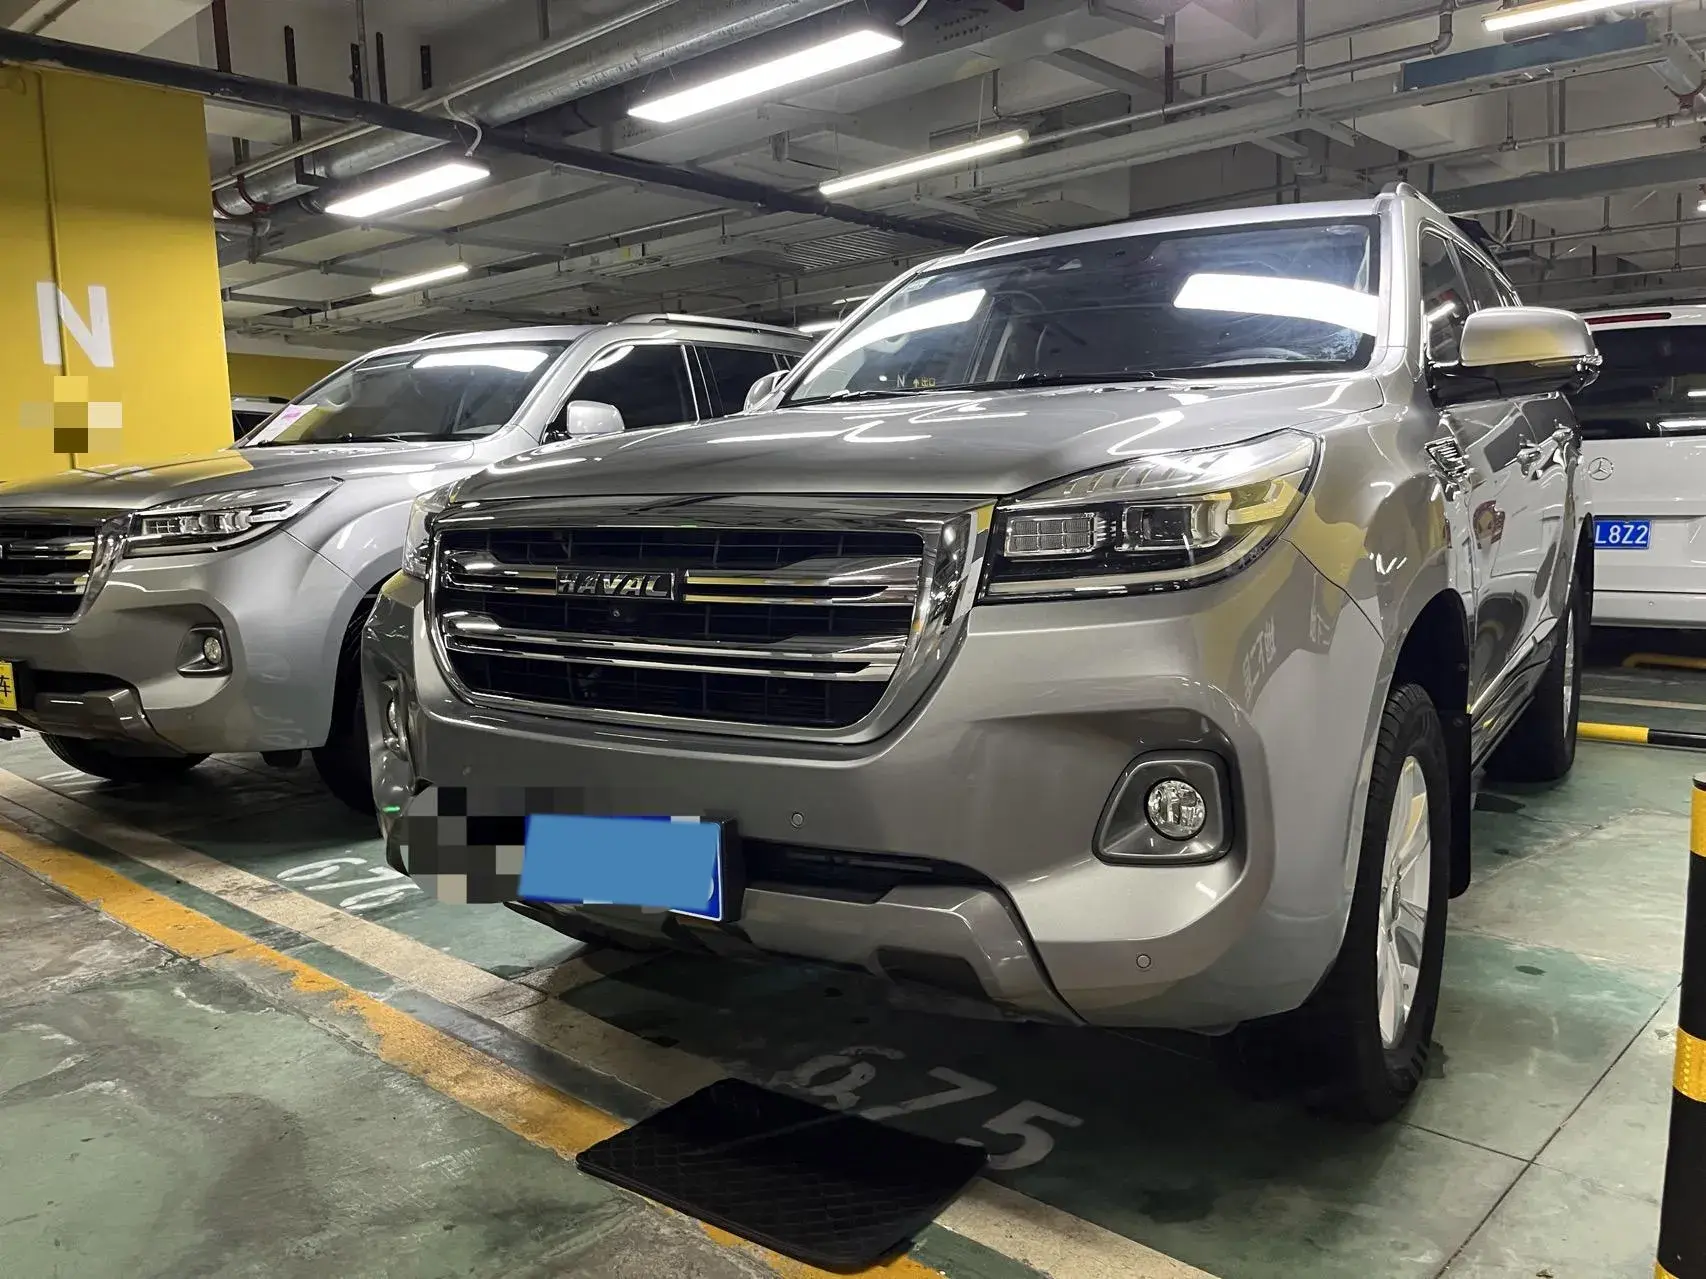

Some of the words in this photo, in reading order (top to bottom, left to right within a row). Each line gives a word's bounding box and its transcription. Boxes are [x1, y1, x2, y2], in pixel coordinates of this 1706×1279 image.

[36, 281, 114, 368] N
[896, 373, 906, 388] N
[1594, 524, 1649, 544] L8Z2
[557, 572, 668, 597] HAVAL
